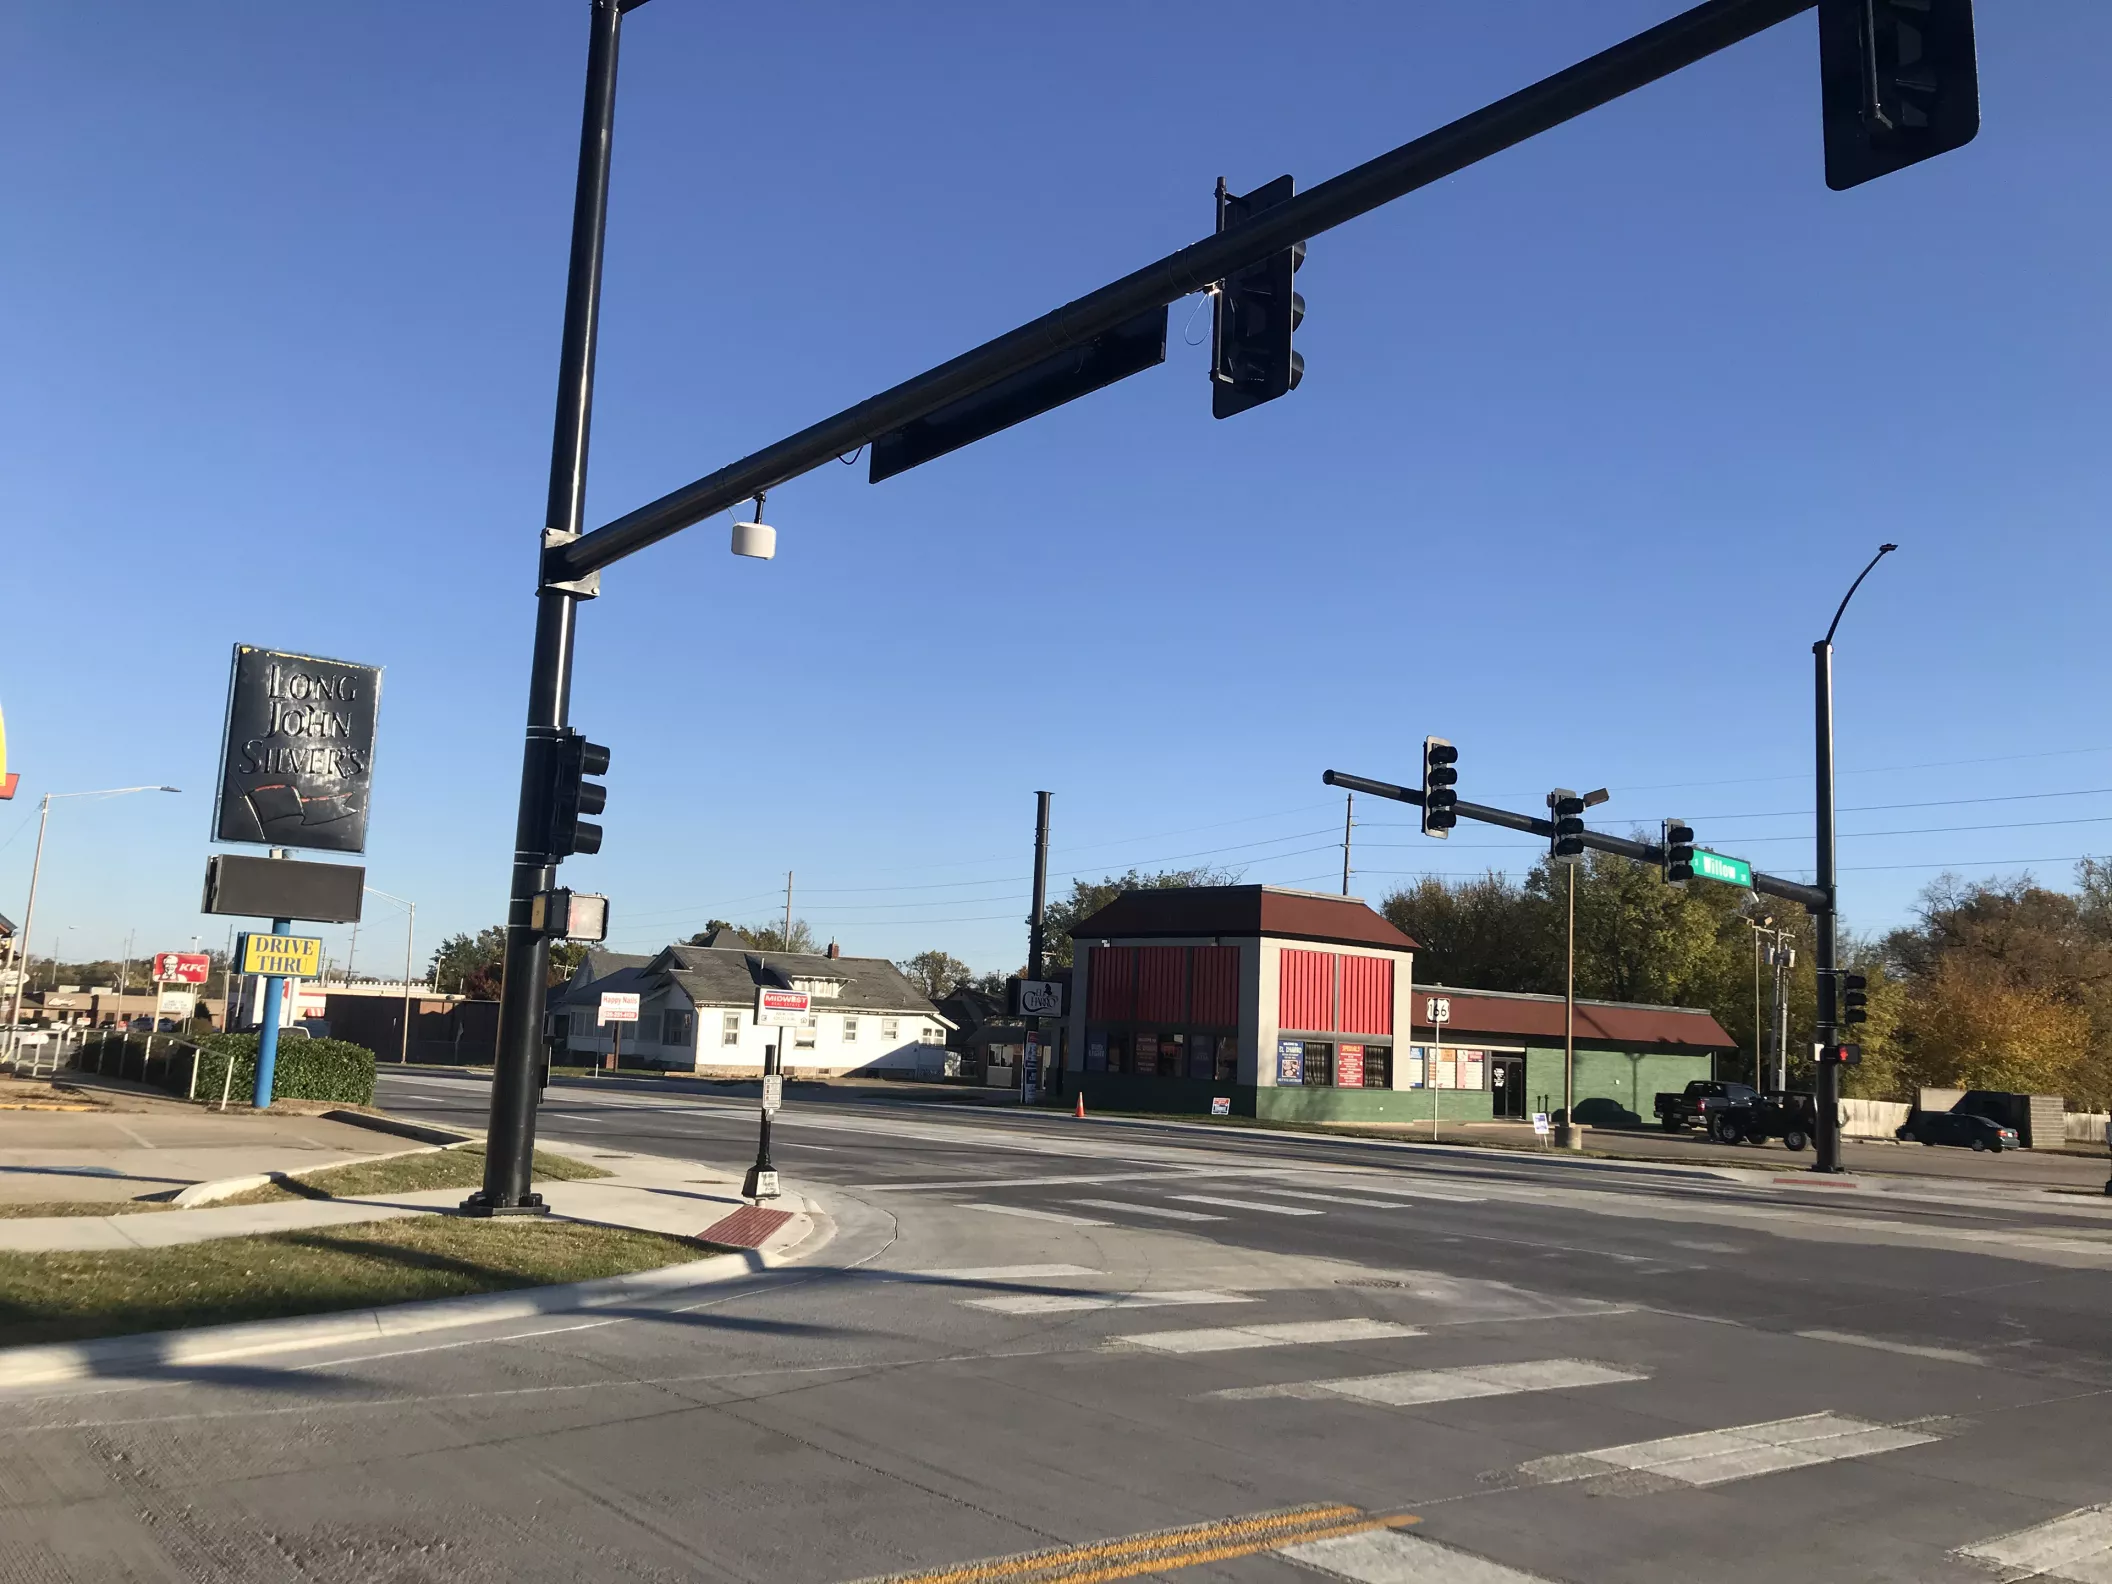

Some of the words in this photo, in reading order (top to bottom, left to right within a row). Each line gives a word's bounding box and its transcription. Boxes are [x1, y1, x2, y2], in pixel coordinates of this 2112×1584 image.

[268, 664, 358, 701] LONG
[260, 701, 351, 739] JOHN
[239, 740, 366, 779] SILVER'S
[255, 937, 314, 955] DRIVE
[178, 963, 206, 972] KFC
[257, 955, 309, 973] THRU
[603, 996, 621, 1005] Happy
[622, 996, 638, 1004] Nails
[765, 995, 807, 1003] MIDWEST
[1428, 1003, 1447, 1017] 166
